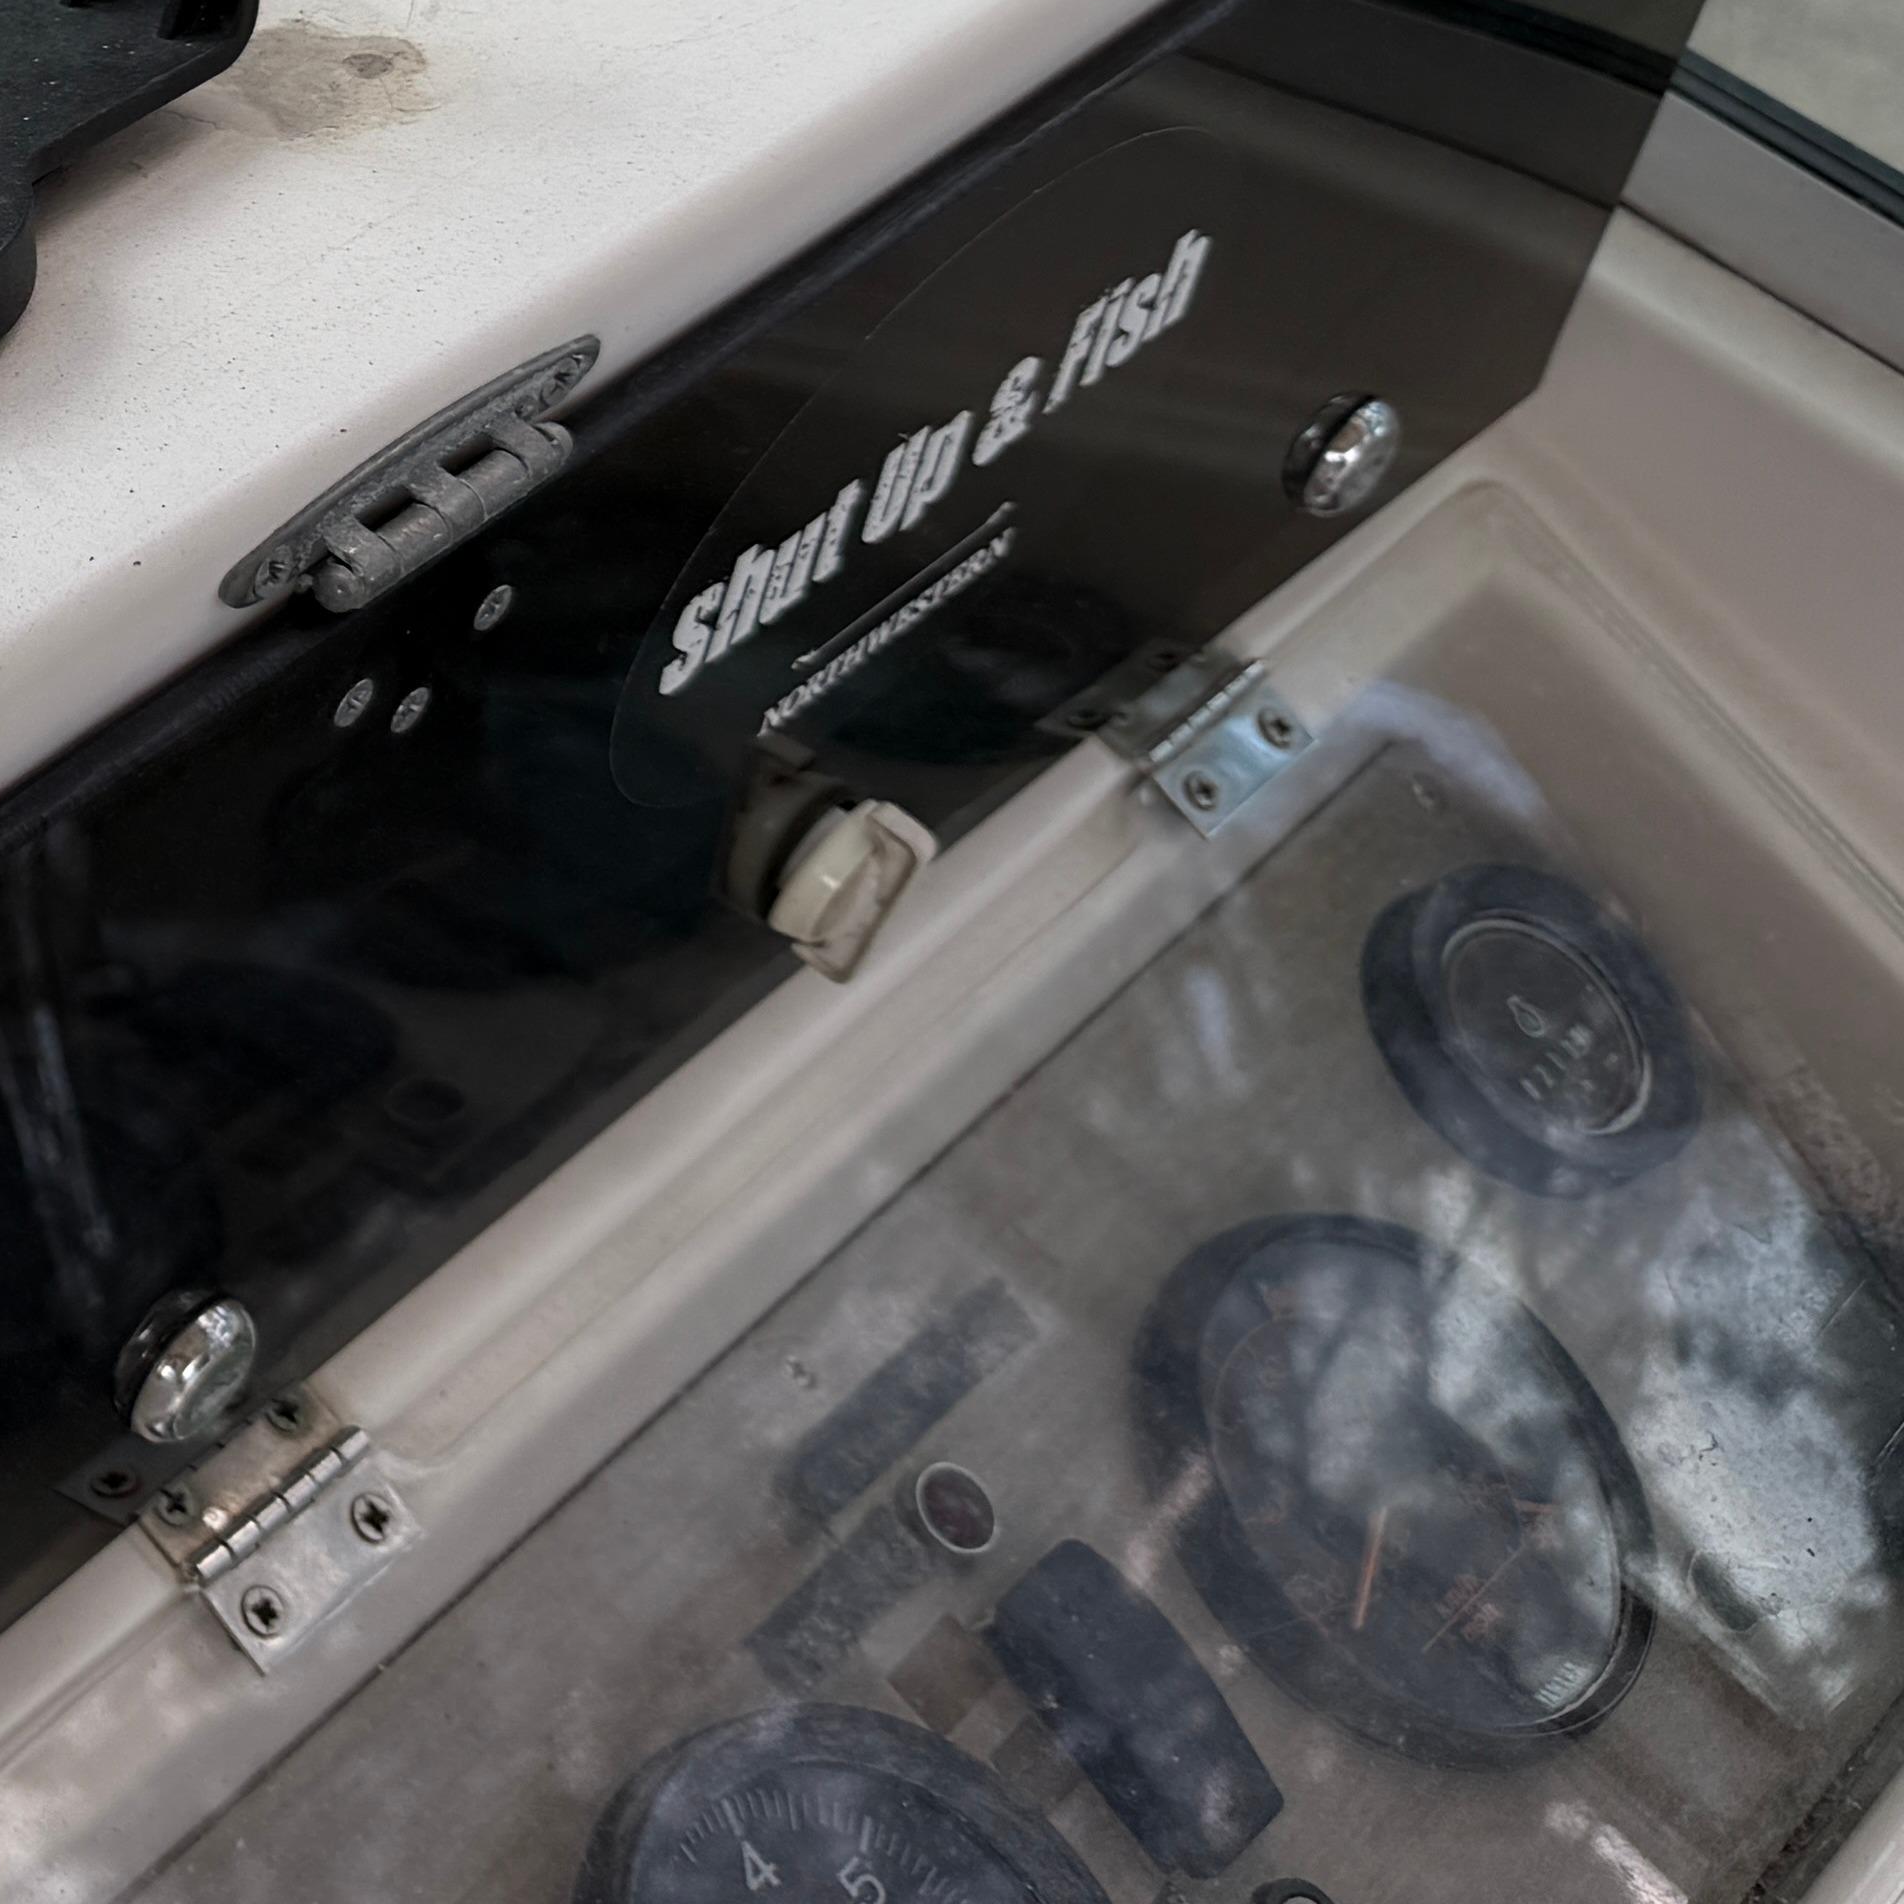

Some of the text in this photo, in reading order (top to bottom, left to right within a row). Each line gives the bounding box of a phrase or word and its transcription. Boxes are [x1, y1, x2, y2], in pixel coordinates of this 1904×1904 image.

[659, 229, 1212, 696] Shut Up & Fish
[741, 1839, 783, 1892] 4
[835, 1856, 887, 1904] 5
